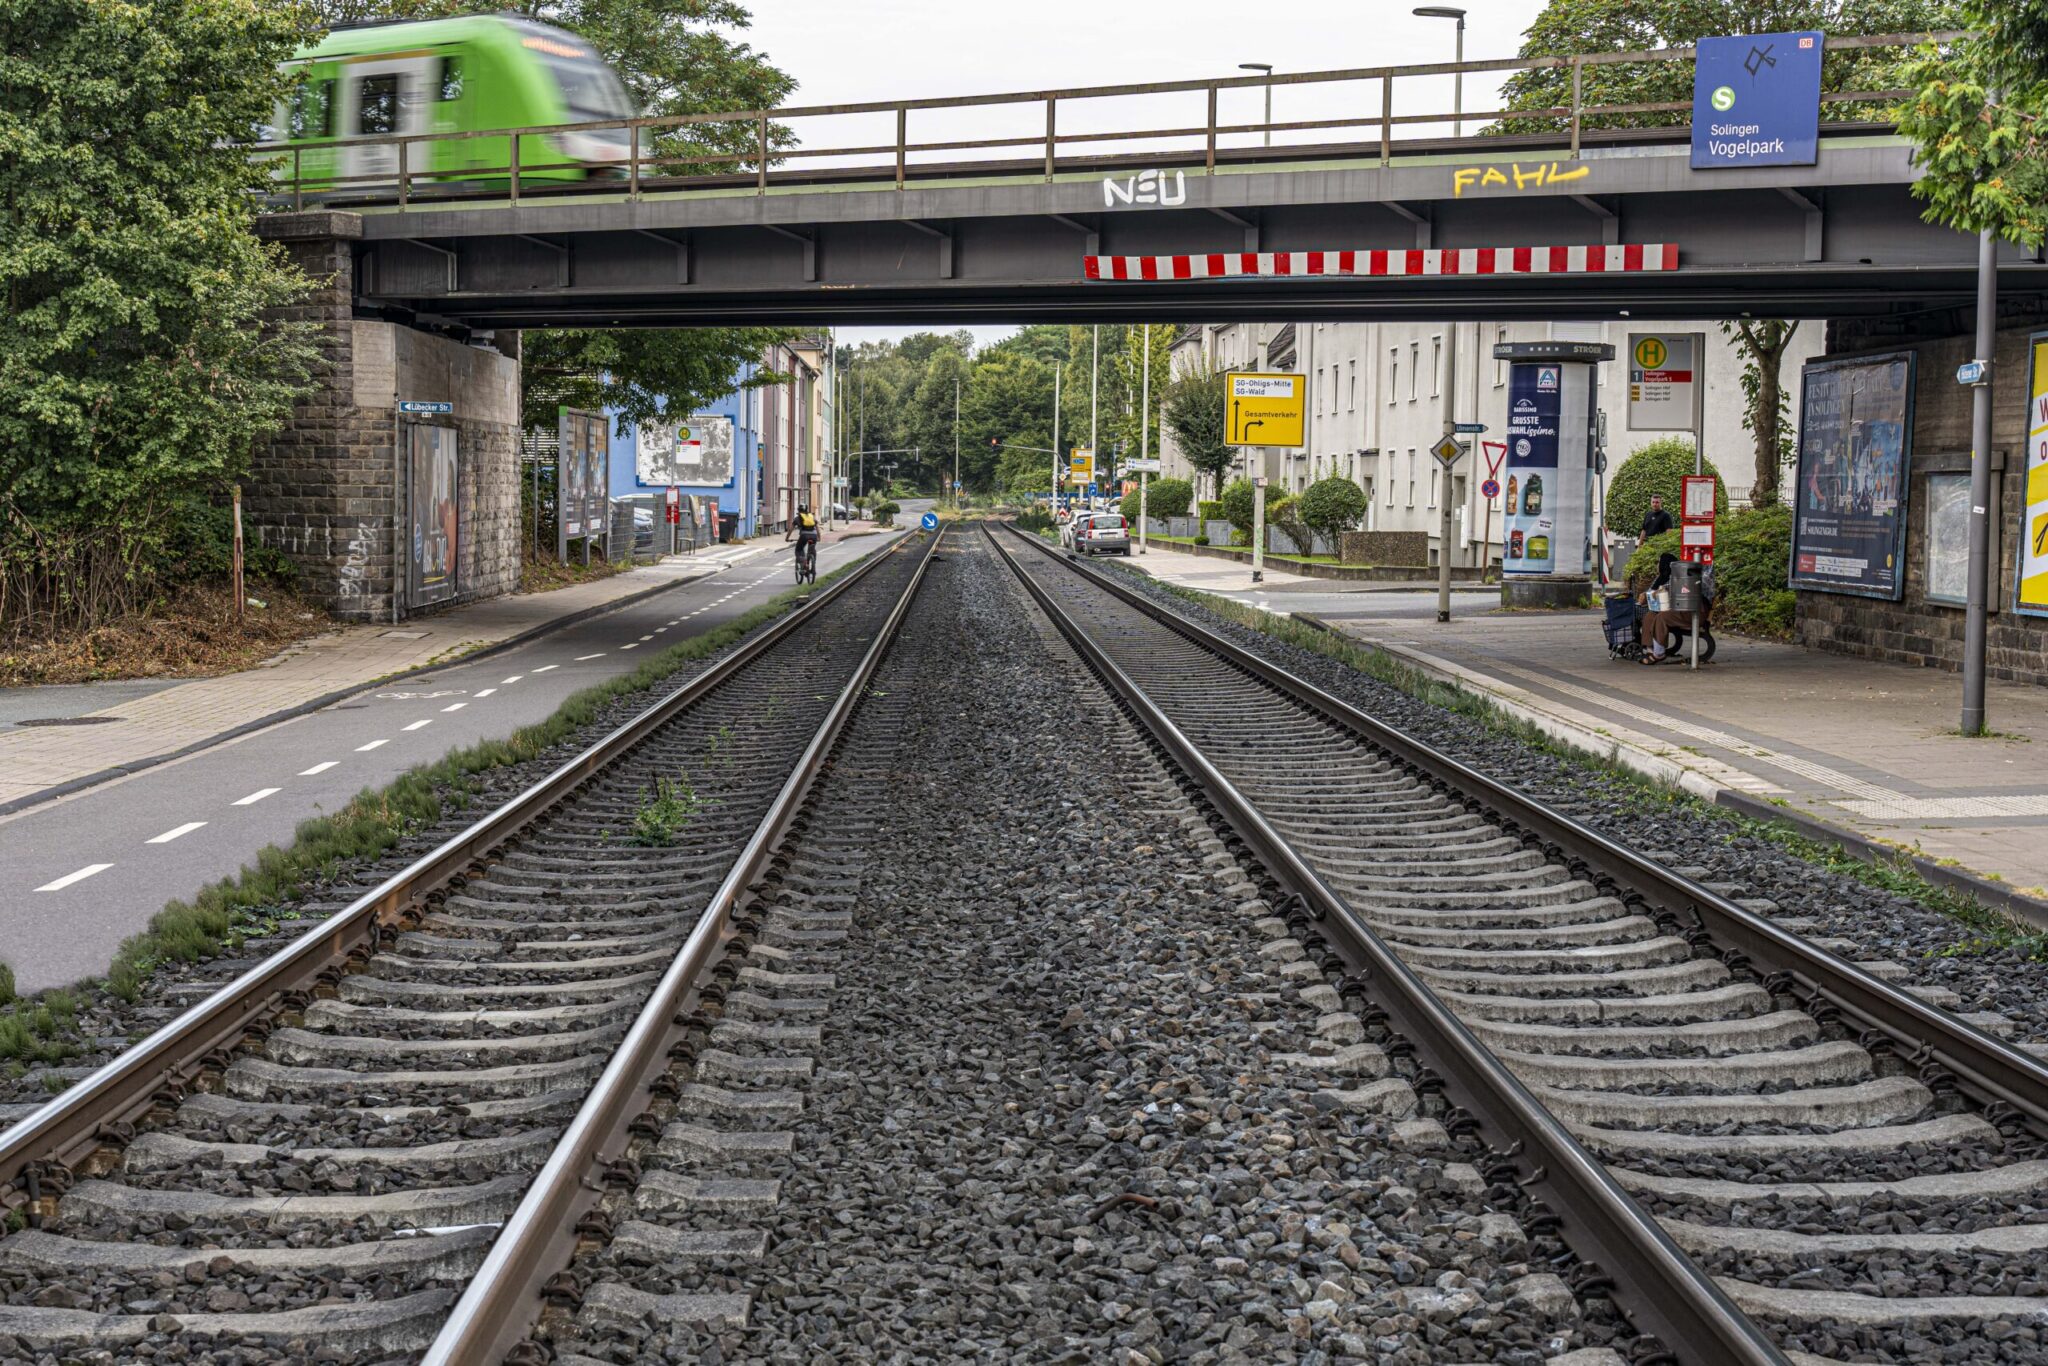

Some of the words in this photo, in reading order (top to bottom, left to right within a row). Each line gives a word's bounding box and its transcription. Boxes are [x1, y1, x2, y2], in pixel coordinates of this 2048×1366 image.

[1800, 39, 1812, 48] DB
[1715, 89, 1732, 109] S
[1711, 123, 1759, 137] Solingen
[1709, 138, 1784, 158] Vogelpark
[1103, 168, 1186, 207] NEU
[1643, 344, 1659, 363] H
[1235, 379, 1292, 388] SG-Ohligs-Mitte
[1235, 388, 1265, 396] SG-Wald
[411, 403, 438, 411] Lübecker
[1244, 410, 1298, 419] Gesamtverkehr
